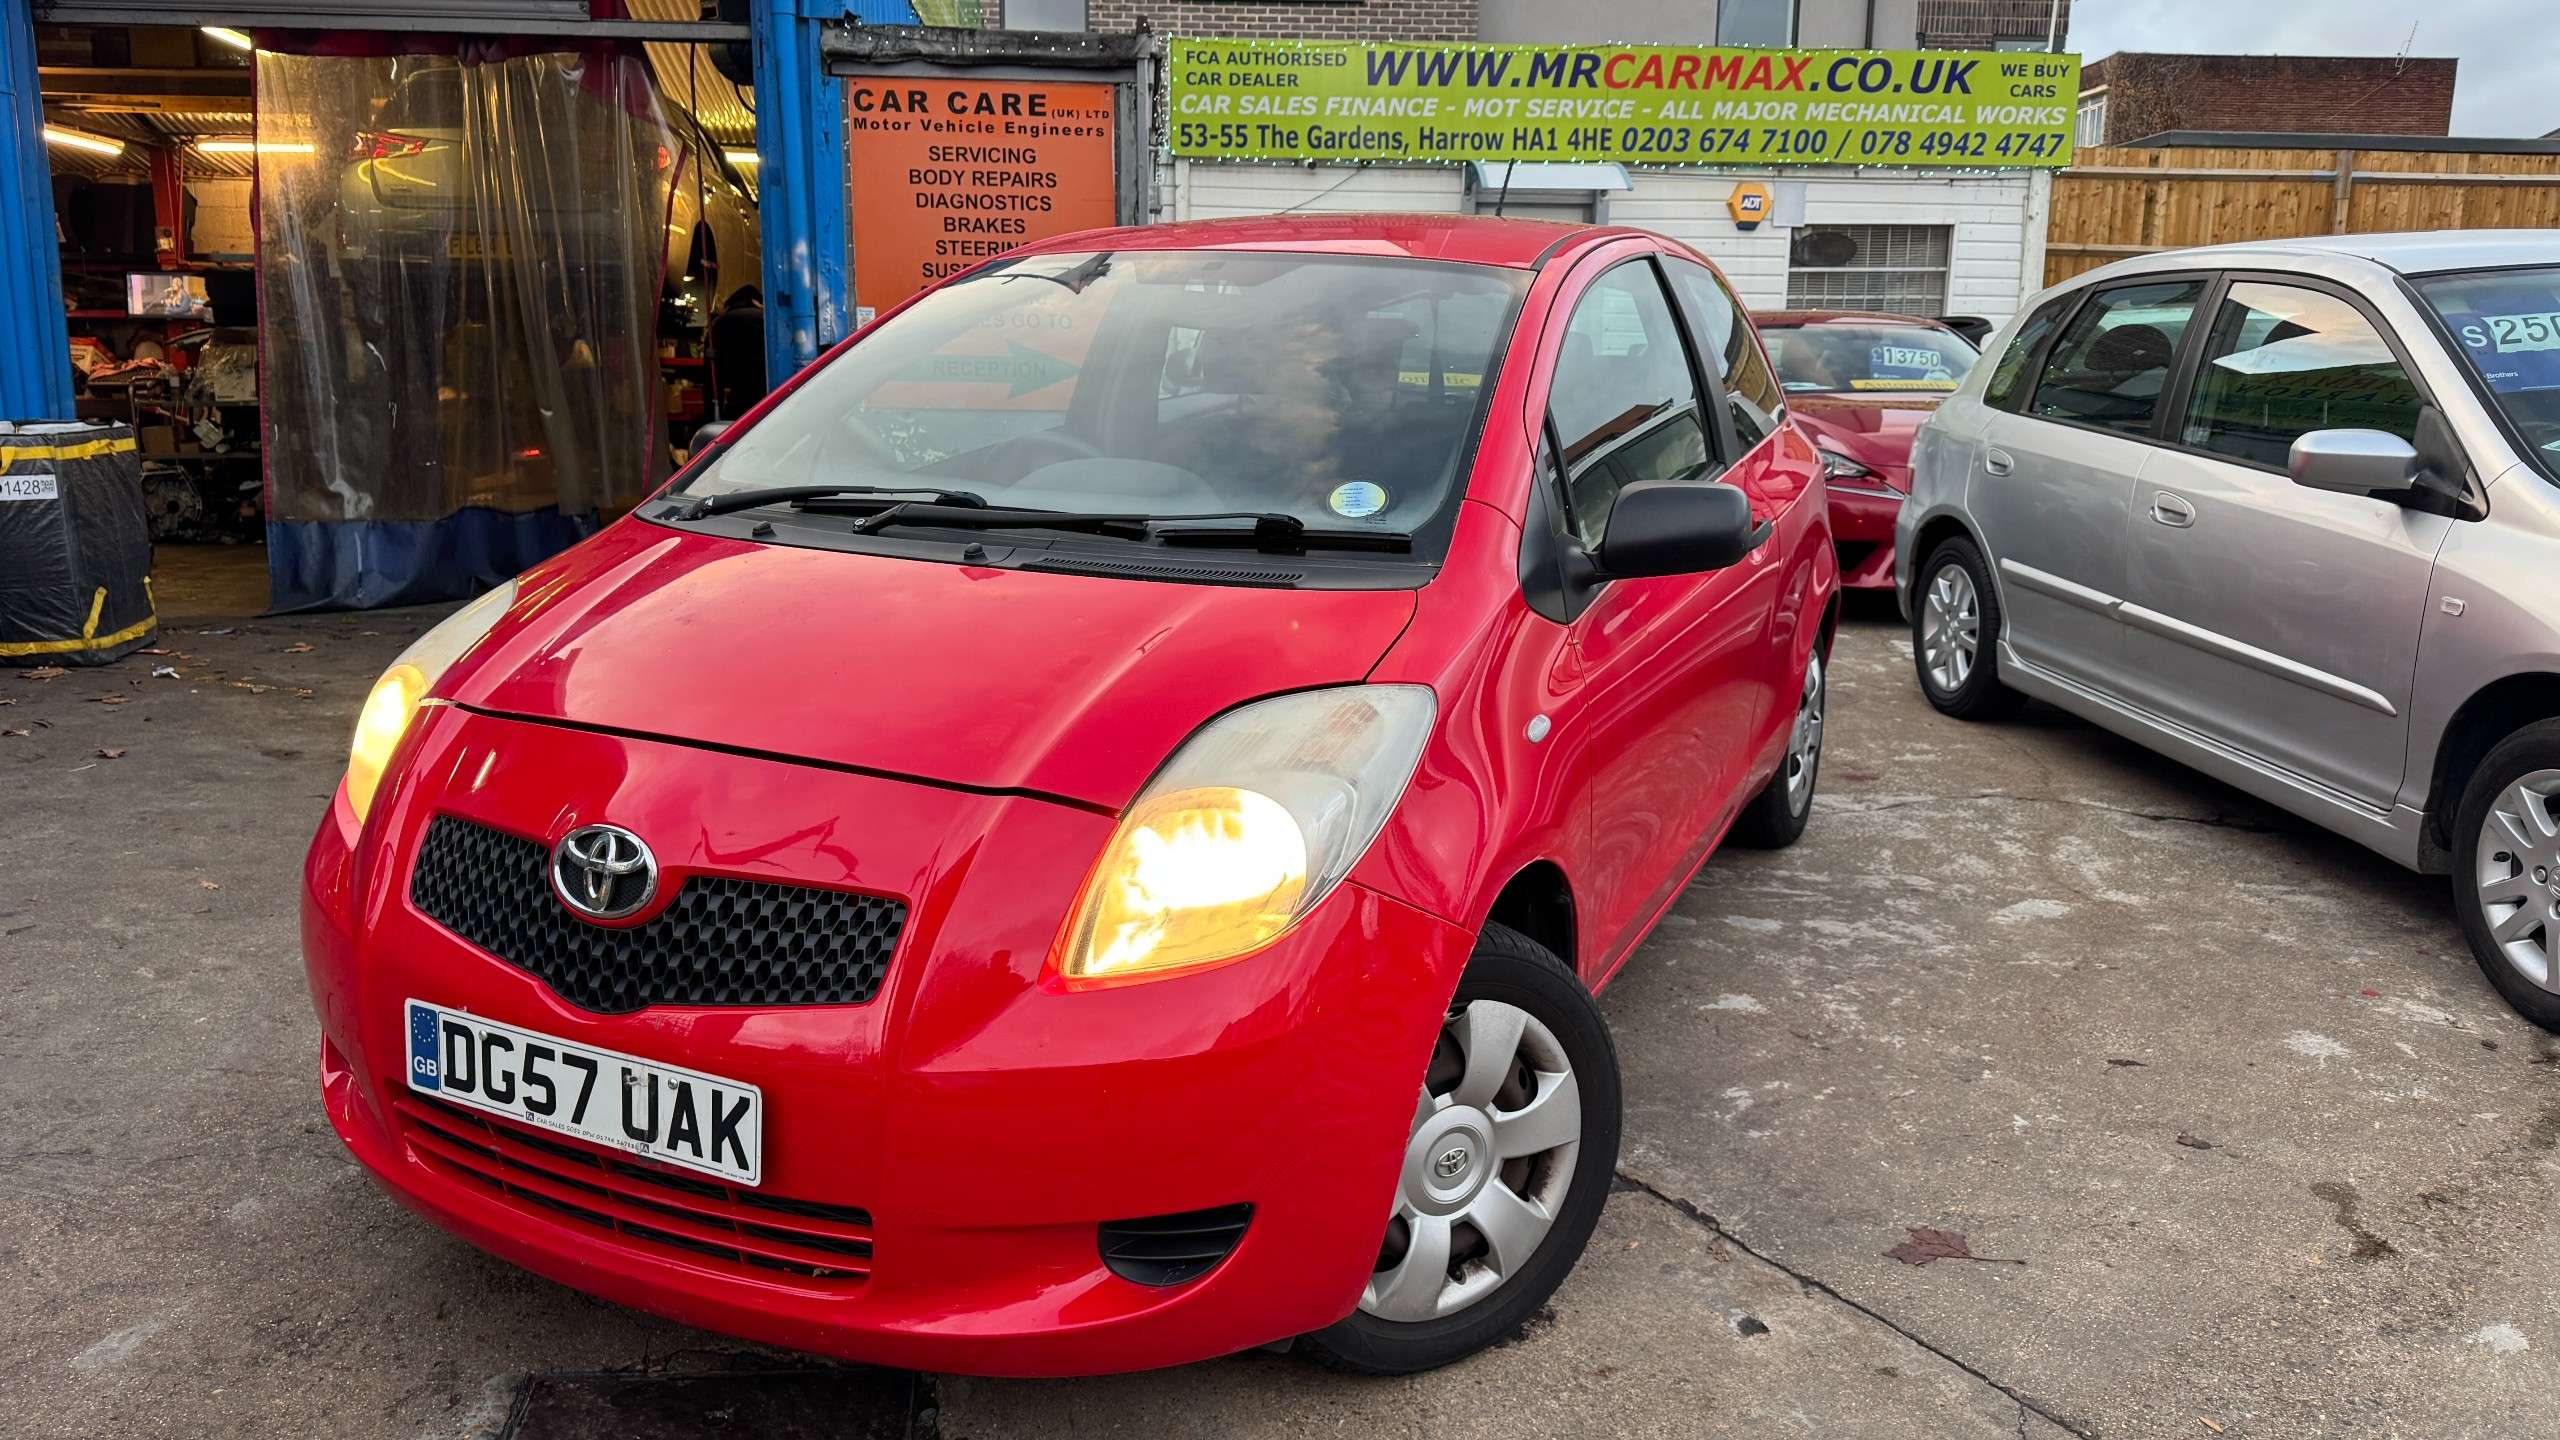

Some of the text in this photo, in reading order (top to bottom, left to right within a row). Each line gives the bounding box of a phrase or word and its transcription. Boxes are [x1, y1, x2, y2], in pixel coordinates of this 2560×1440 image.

[1185, 50, 1348, 68] FCA AUTHORISED
[1185, 72, 1299, 88] CAR DEALER
[1366, 51, 1979, 95] WWW.MRCARMAX.CO.UK
[2001, 63, 2071, 79] WE BUY
[2009, 83, 2057, 99] CARS
[853, 88, 1109, 119] CAR CARE (UK) LTD
[1179, 94, 1231, 115] CAR
[1238, 95, 1317, 117] SALES
[1324, 95, 1439, 118] FINANCE
[1463, 98, 1520, 119] MOT
[1525, 99, 1635, 119] SERVICE
[1658, 100, 1703, 121] ALL
[1712, 102, 1797, 123] MAJOR
[1804, 103, 1967, 125] MECHANICAL
[1974, 105, 2067, 126] WORKS
[853, 117, 1106, 138] Motor Vehicle Engineers
[1180, 123, 1248, 149] 53-55
[1256, 123, 1299, 150] The
[1307, 124, 1409, 154] Gardens,
[1419, 126, 1504, 152] Harrow
[1512, 127, 1558, 153] HA1
[1567, 127, 1613, 154] 4HE
[1622, 127, 1690, 154] 0203
[1700, 128, 1750, 155] 674
[1761, 129, 1827, 155] 7100
[1860, 131, 1911, 156] 078
[1919, 131, 1987, 158] 4942
[1995, 131, 2065, 158] 4747
[928, 145, 1037, 164] SERVICING
[908, 169, 1057, 188] BODY REPAIRS
[915, 192, 1051, 211] DIAGNOSTICS
[1742, 196, 1760, 208] ADT
[943, 216, 1026, 234] BRAKES
[935, 239, 1031, 256] STEERIN
[414, 1055, 437, 1077] GB
[442, 1020, 751, 1171] DG57 UAK
